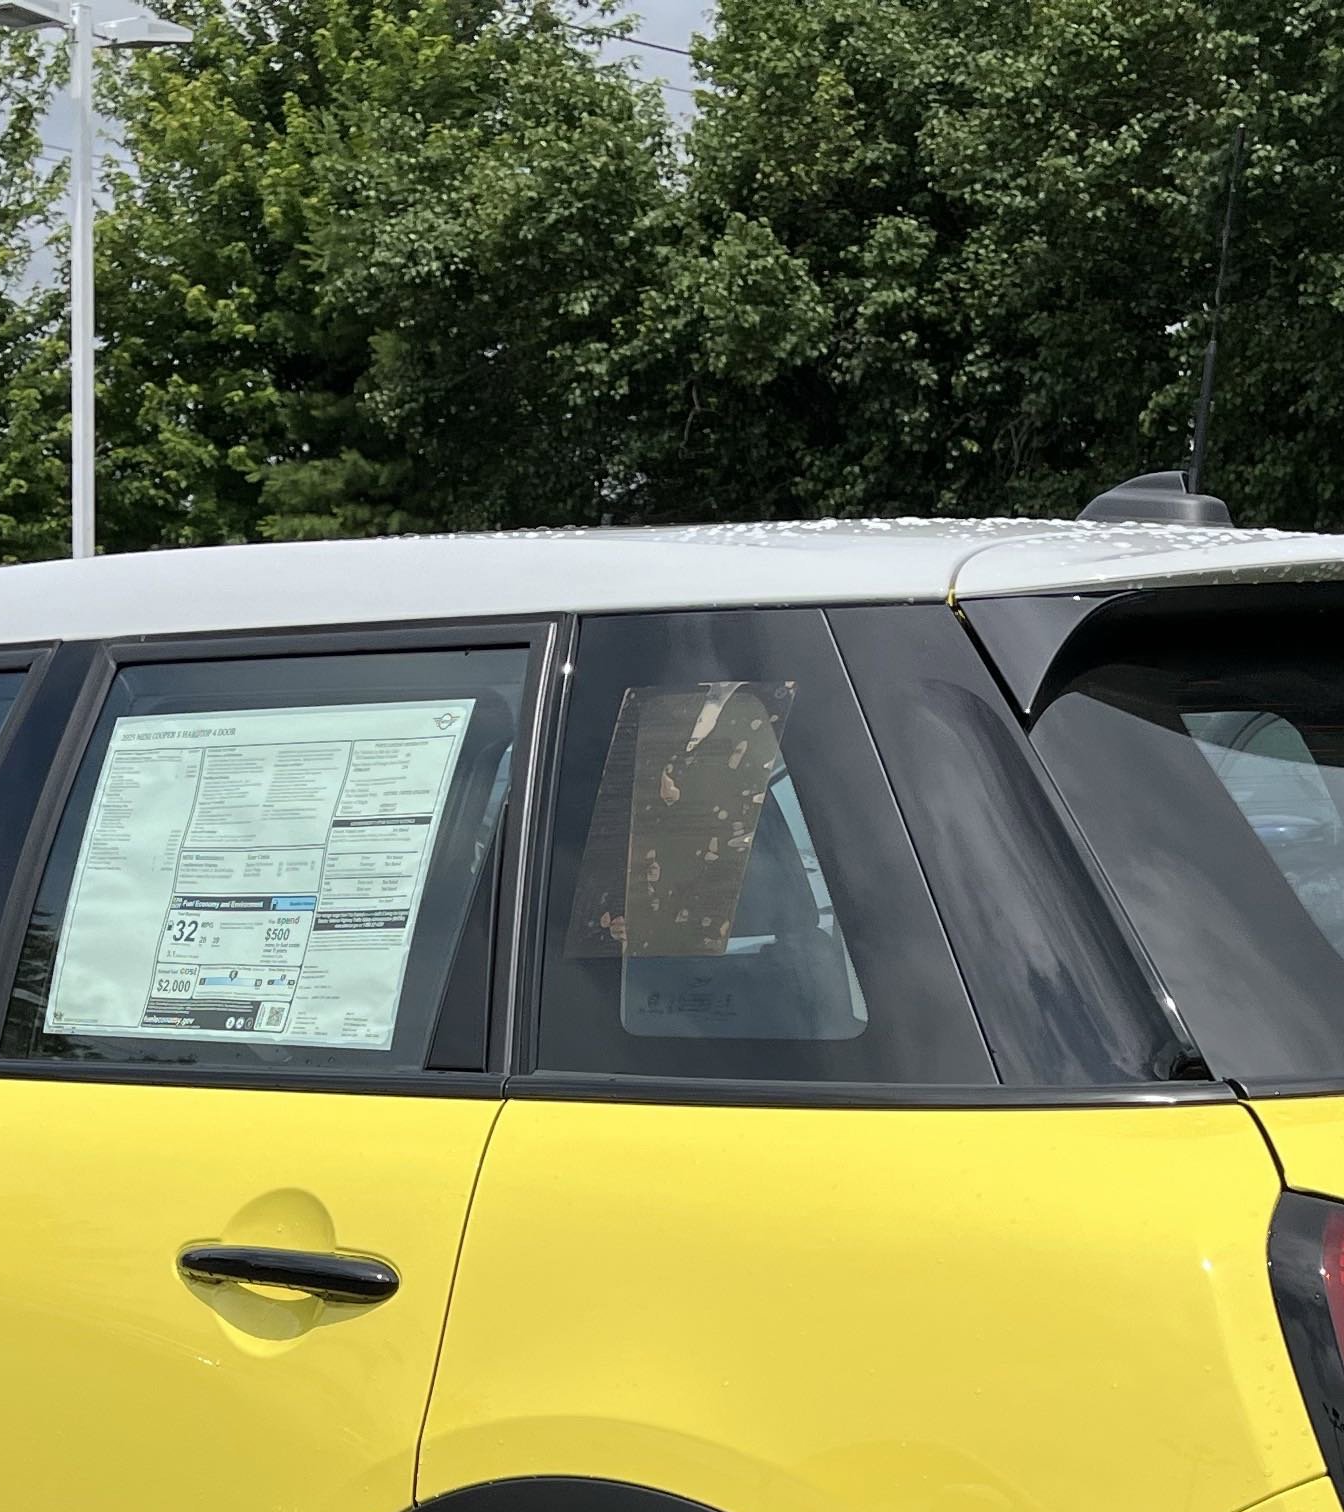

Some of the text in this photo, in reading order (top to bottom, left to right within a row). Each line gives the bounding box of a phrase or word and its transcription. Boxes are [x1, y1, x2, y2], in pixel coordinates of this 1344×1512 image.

[151, 729, 176, 740] COOPER
[218, 727, 236, 737] DOOR
[277, 916, 300, 926] spend
[172, 919, 198, 942] 32
[265, 928, 290, 941] $500
[180, 968, 197, 976] cost
[157, 979, 191, 993] $2,000
